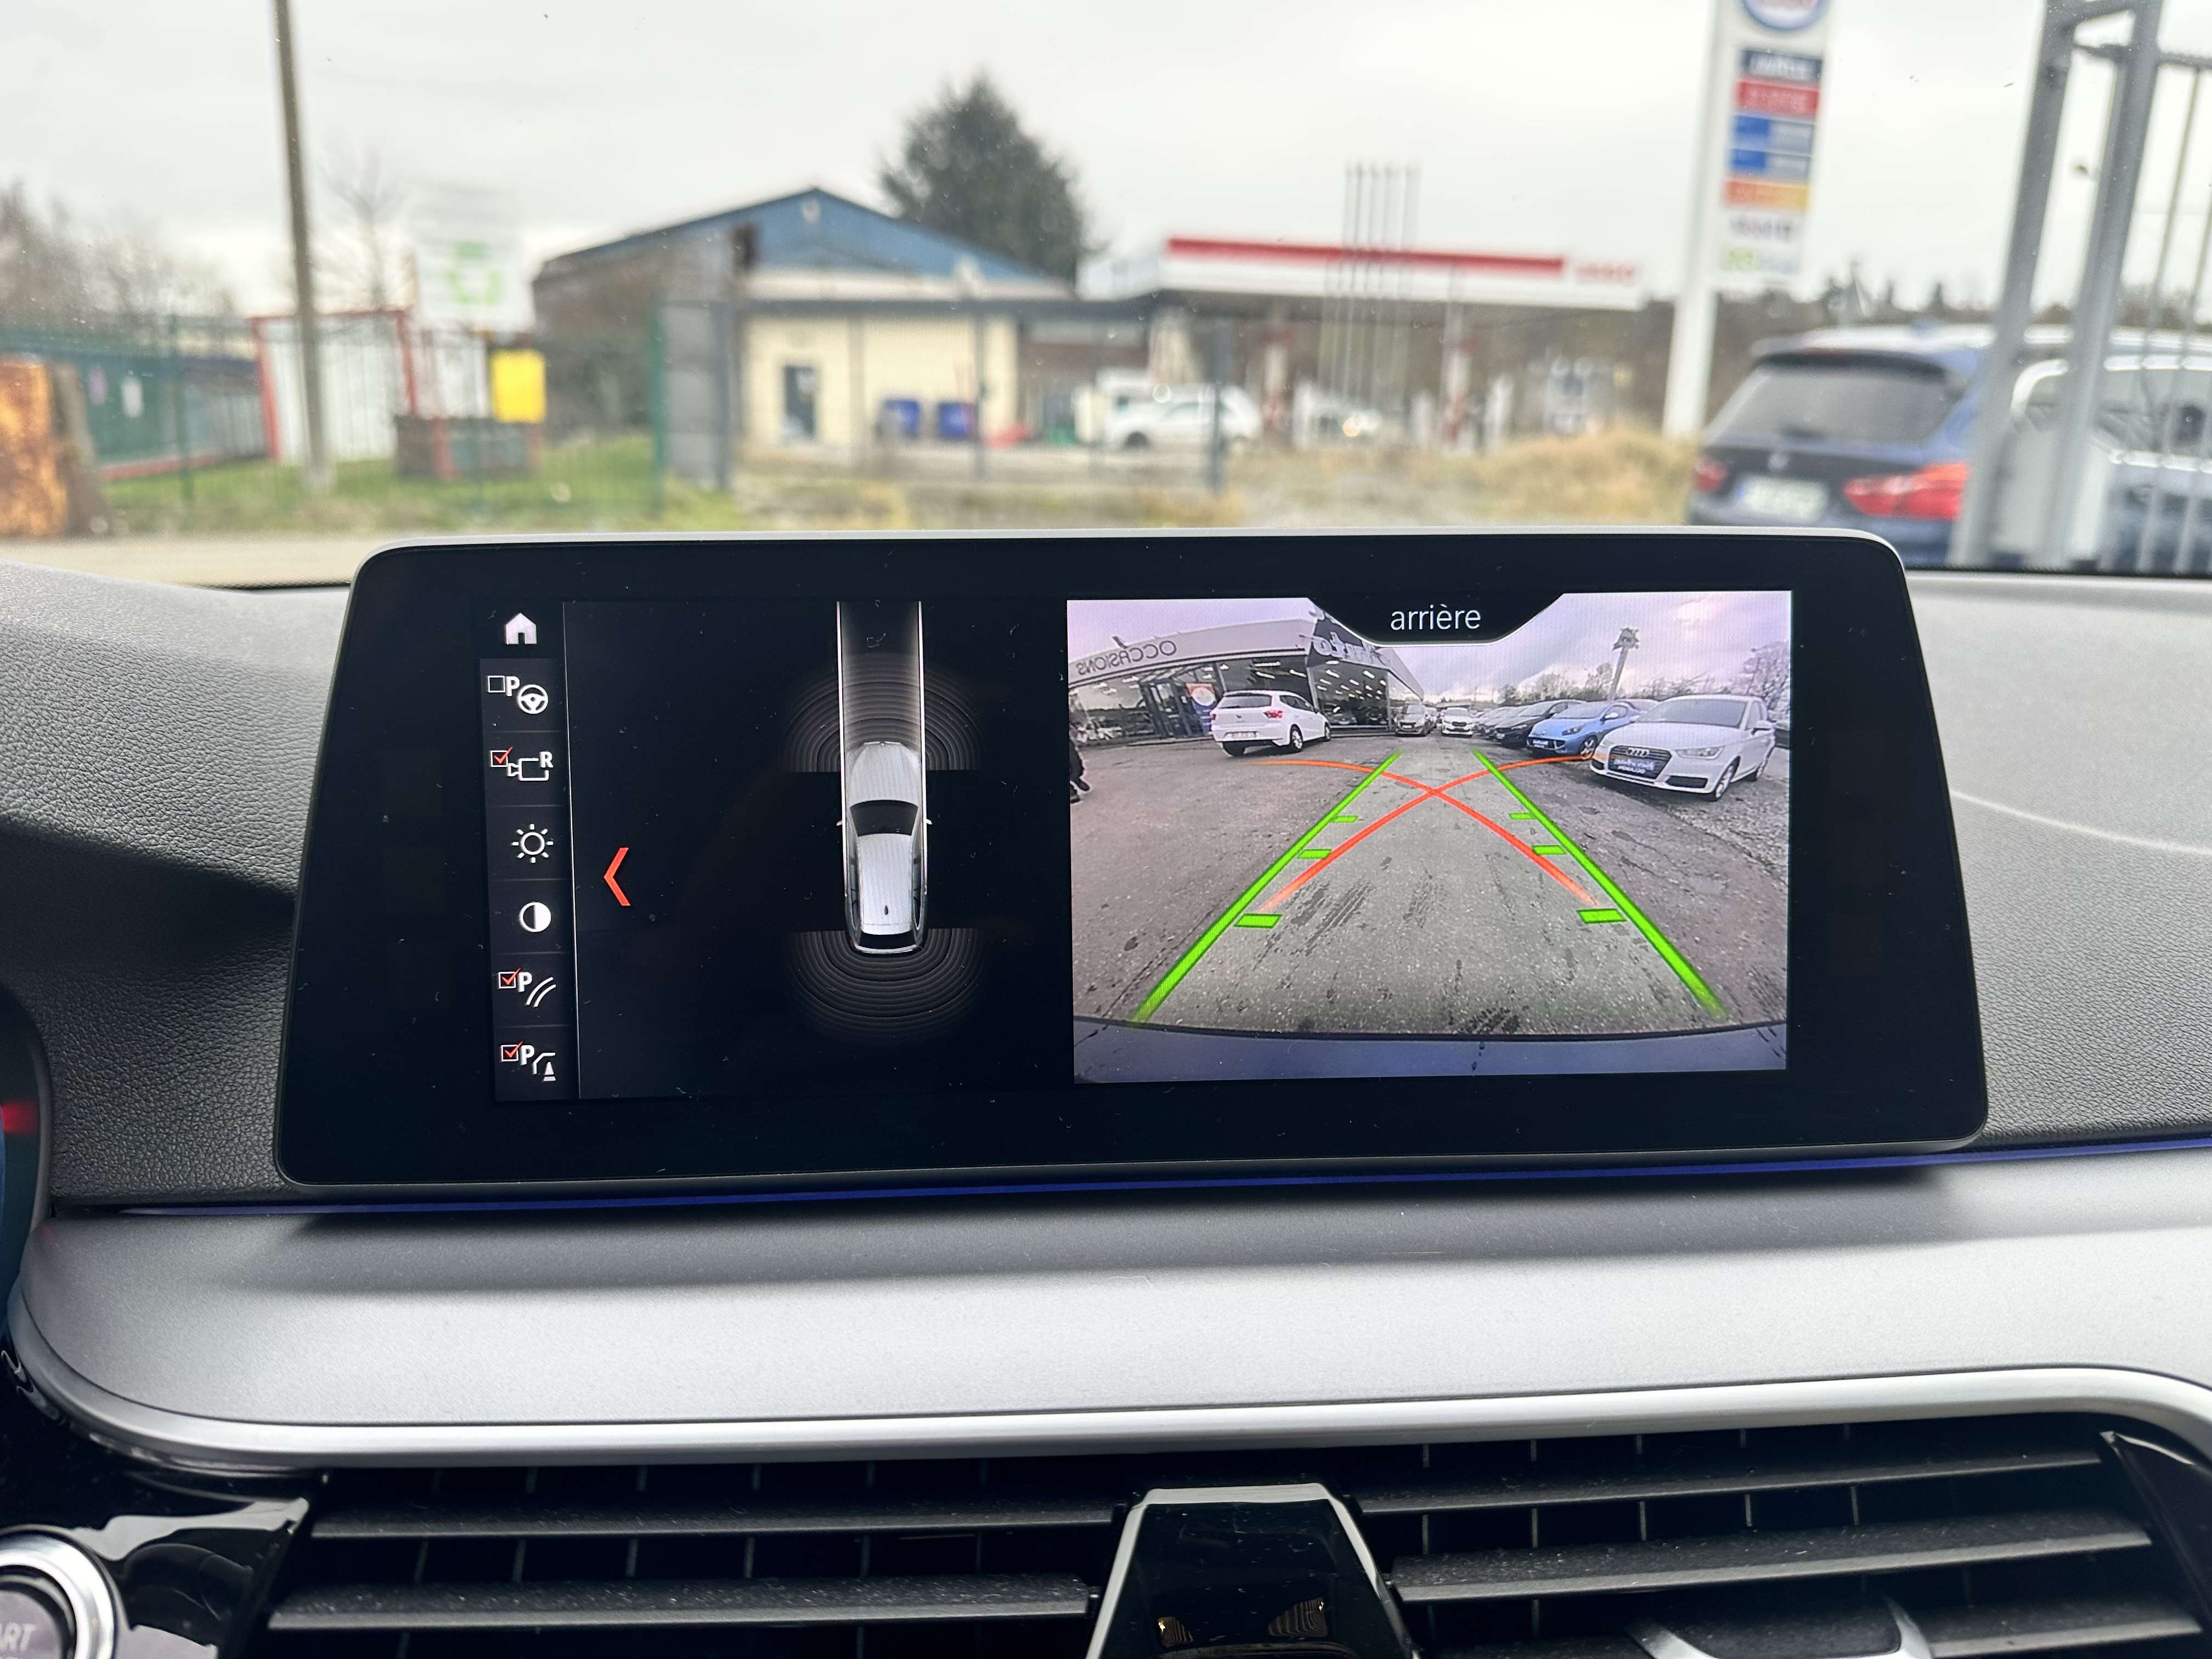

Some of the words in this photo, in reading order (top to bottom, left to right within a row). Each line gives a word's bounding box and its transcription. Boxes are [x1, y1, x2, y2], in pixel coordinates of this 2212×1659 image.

[1391, 603, 1481, 630] arrière
[506, 676, 521, 696] P
[540, 751, 554, 769] R
[518, 971, 532, 992] P
[521, 1045, 535, 1065] P
